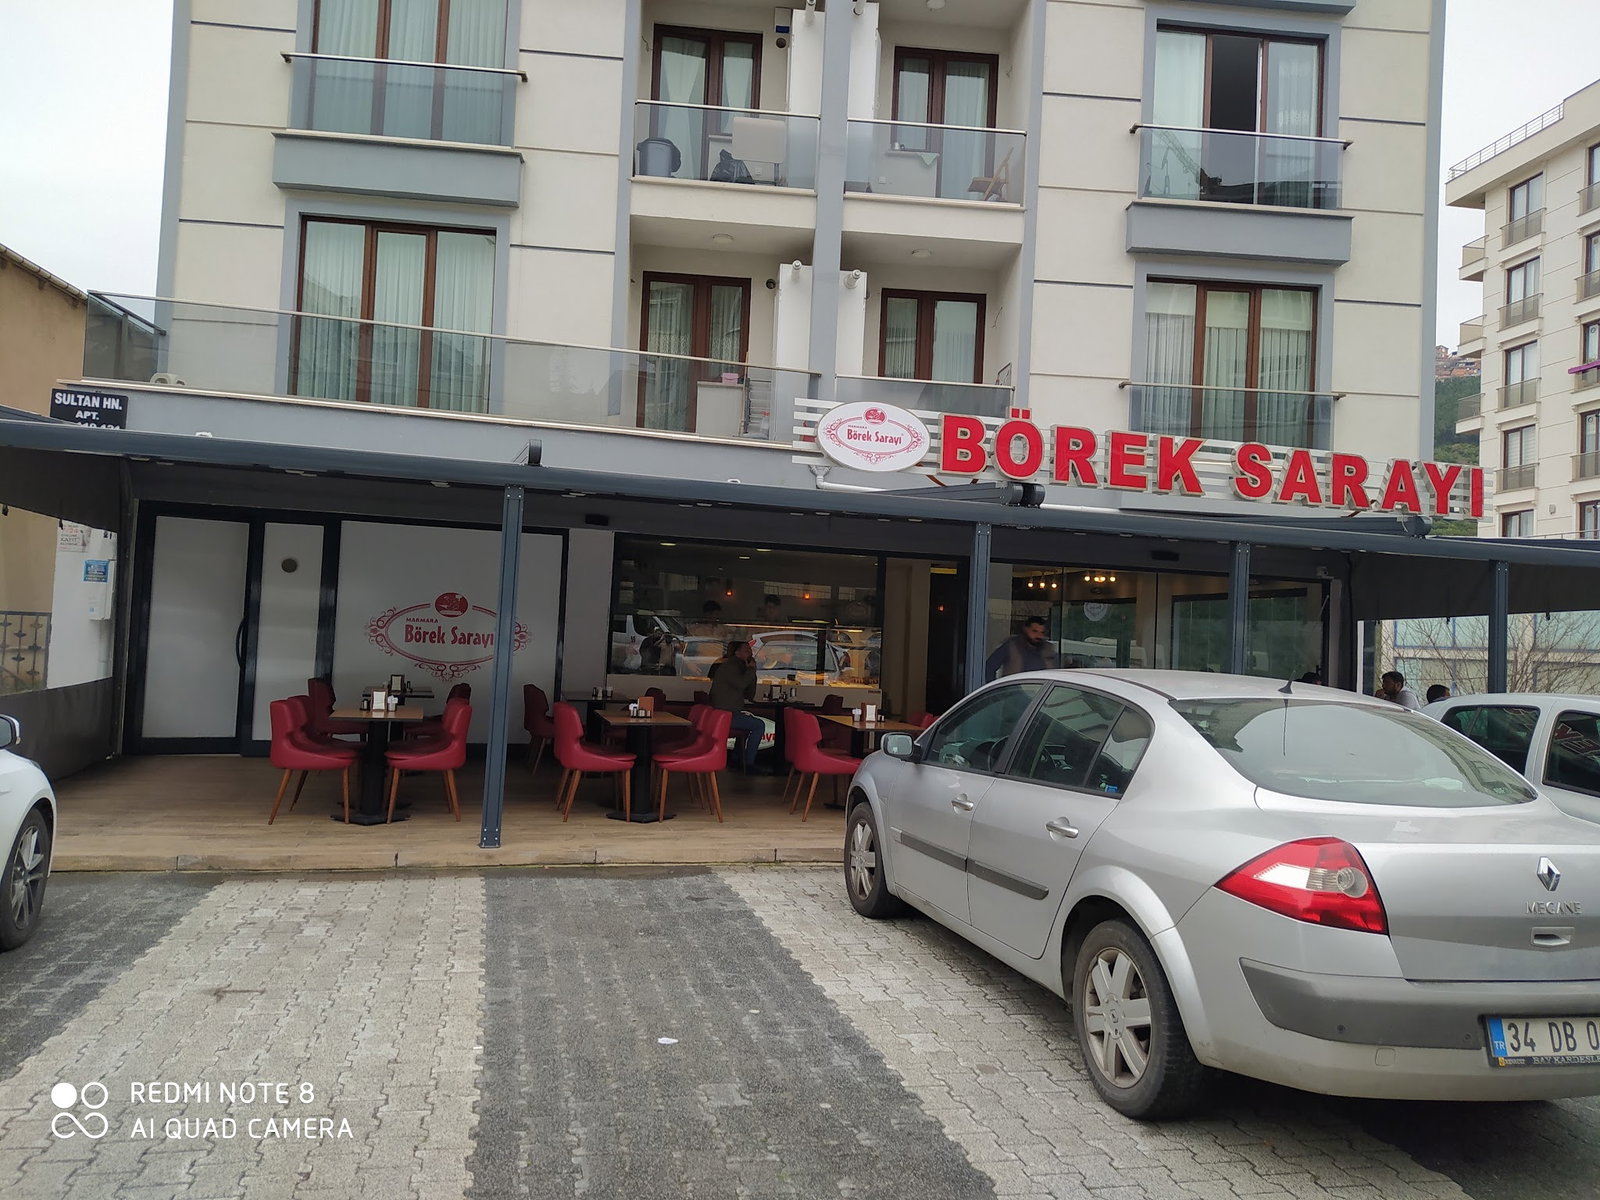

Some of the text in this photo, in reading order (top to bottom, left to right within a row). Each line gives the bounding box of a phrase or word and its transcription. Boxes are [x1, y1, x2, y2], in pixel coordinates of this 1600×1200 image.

[54, 392, 123, 410] SULTAN HN.
[75, 410, 100, 420] APT.
[847, 428, 902, 446] Börek Sarayı
[940, 407, 1485, 519] BÖREK SARAYI
[404, 624, 494, 648] Börek Sarayı
[1493, 1041, 1506, 1050] TR
[1507, 1022, 1536, 1052] 34
[1548, 1021, 1577, 1052] DB
